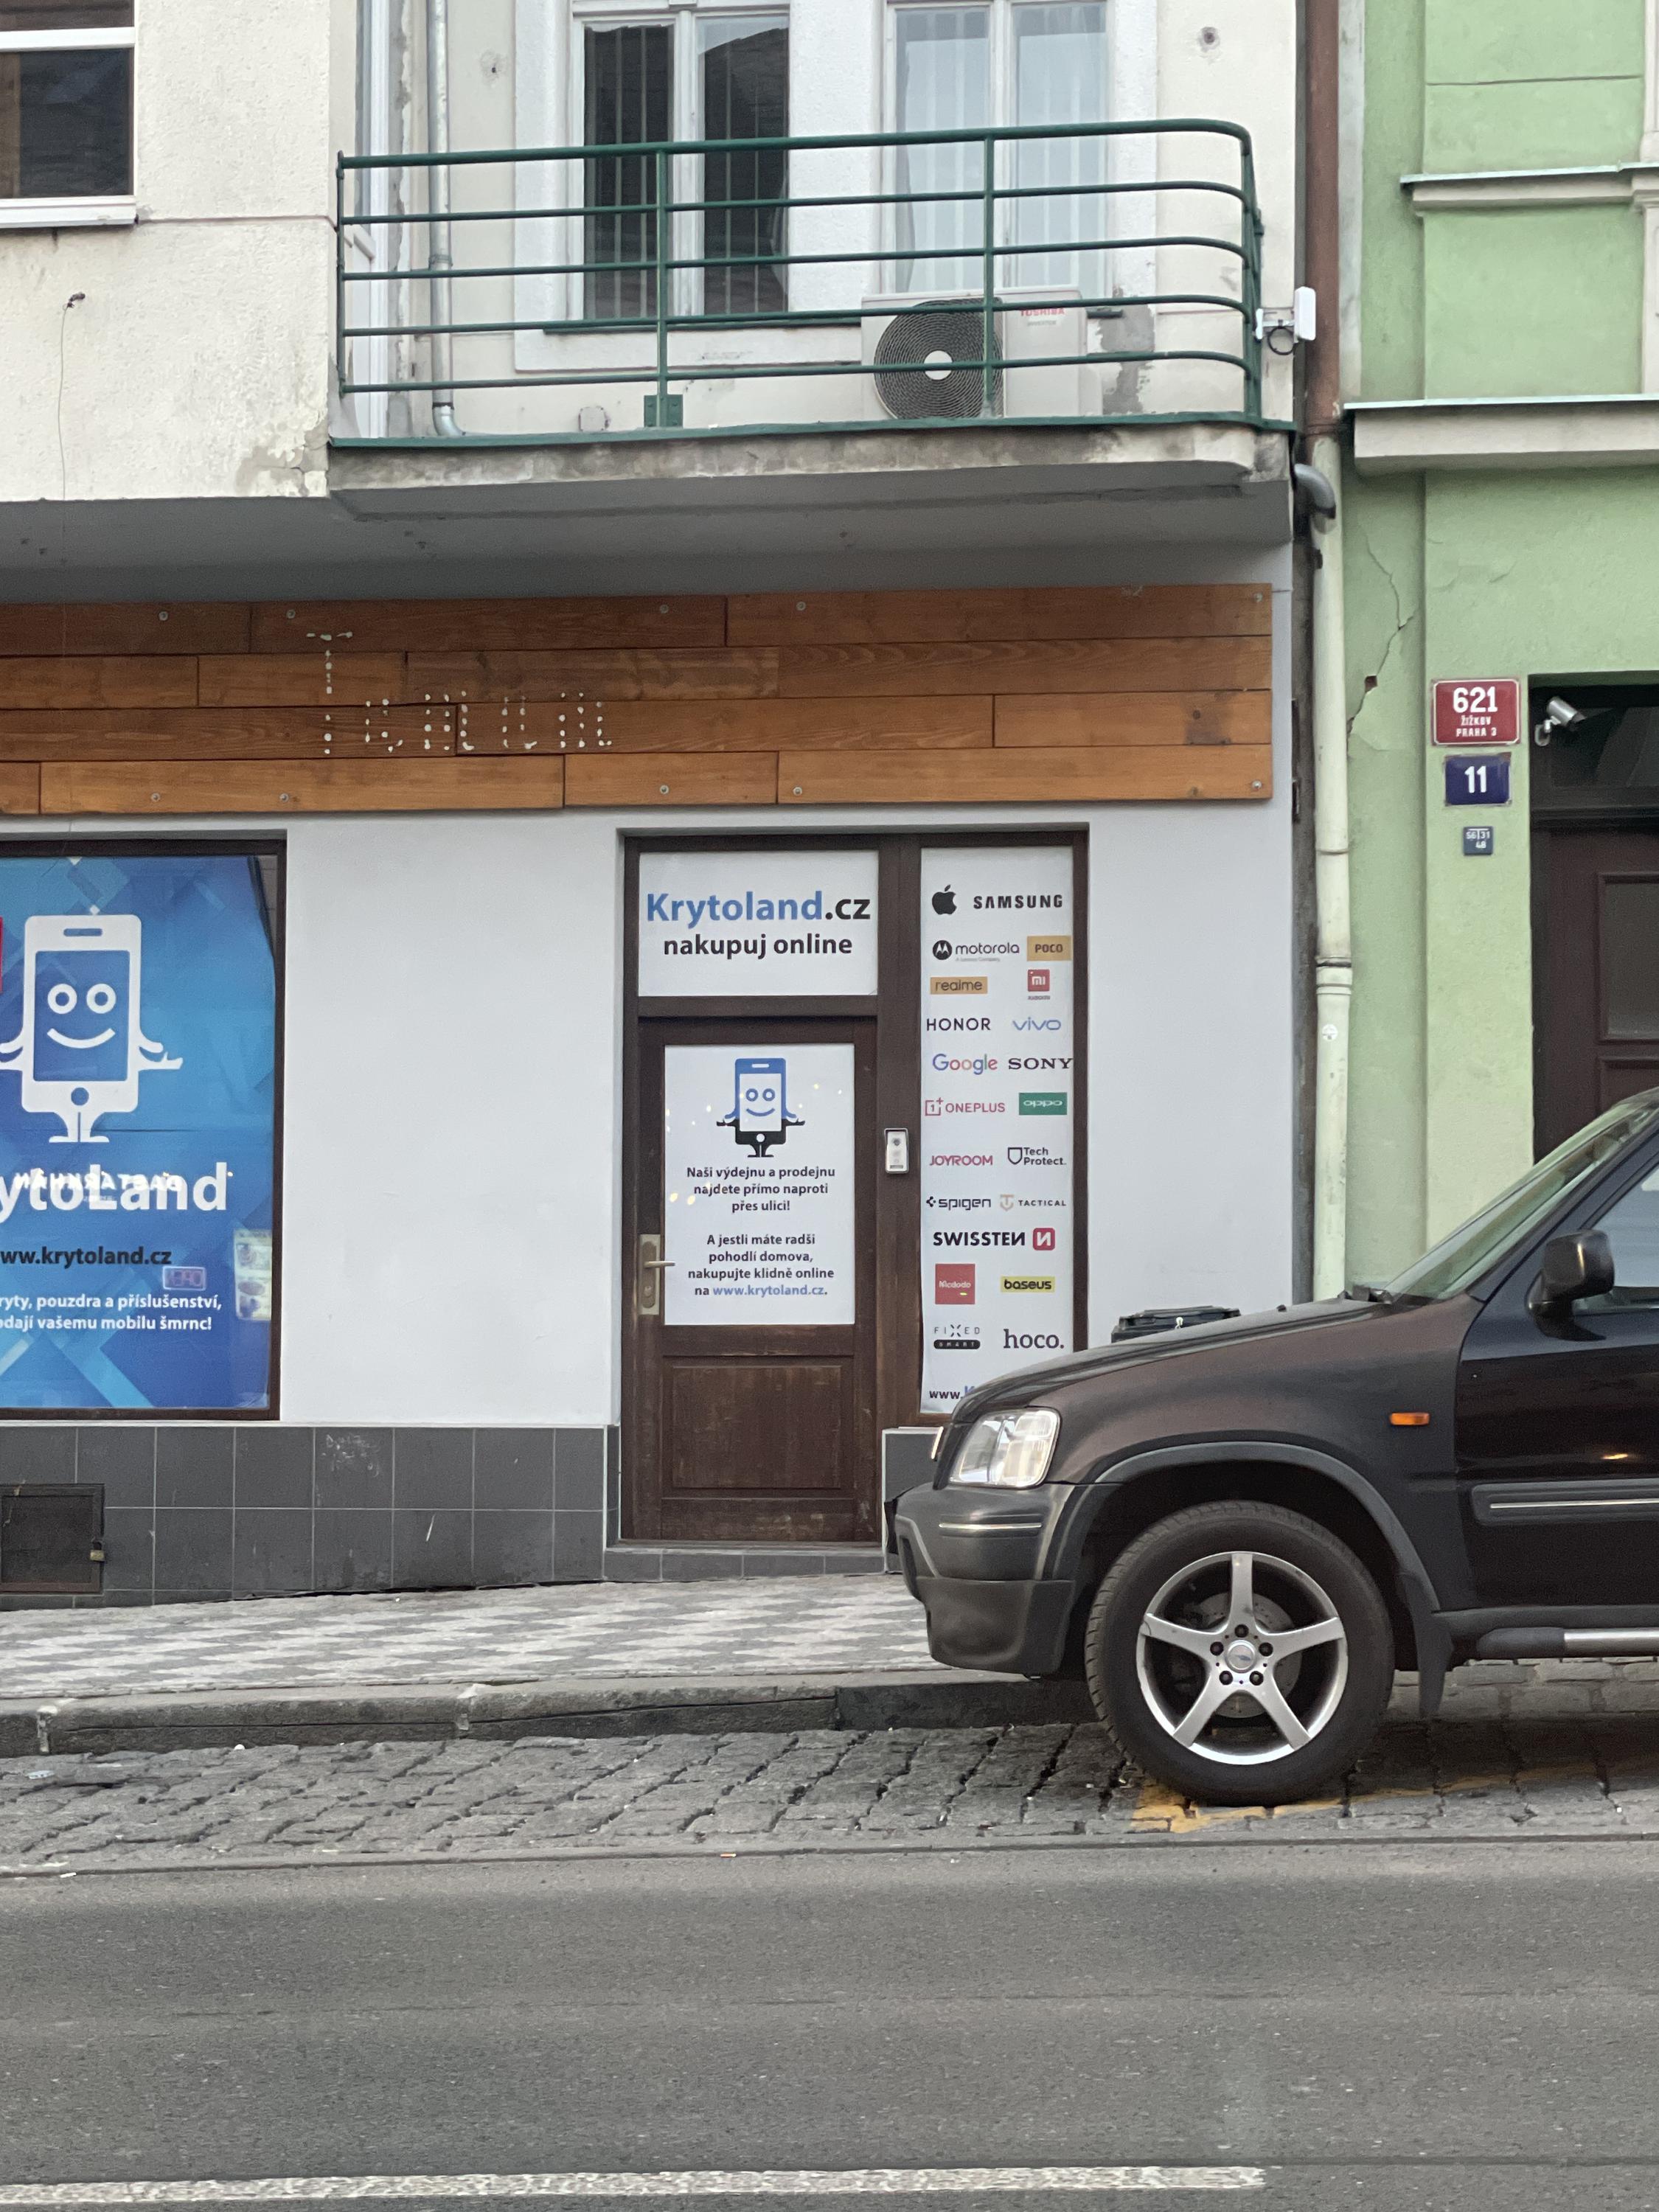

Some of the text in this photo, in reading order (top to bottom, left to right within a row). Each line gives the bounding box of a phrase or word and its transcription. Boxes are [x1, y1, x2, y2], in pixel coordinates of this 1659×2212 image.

[1453, 686, 1498, 713] 621
[1461, 714, 1492, 726] ŽIŽKOV
[1455, 726, 1497, 737] PRAHA 3
[1464, 765, 1487, 793] 11
[973, 894, 1063, 909] SAMSUNG
[647, 890, 872, 929] Krytoland.cz
[664, 933, 853, 960] nakupuj online
[955, 942, 1020, 955] motorola
[1034, 944, 1064, 953] POCO
[935, 980, 983, 991] realme
[926, 1018, 991, 1031] HONOR
[1012, 1017, 1062, 1031] vivo
[932, 1053, 998, 1075] Google
[1008, 1057, 1074, 1070] SONY
[945, 1102, 1006, 1113] ONEPLUS
[1023, 1100, 1063, 1108] oppo
[1023, 1147, 1048, 1156] Tech
[929, 1155, 993, 1166] JOYROOM
[686, 1166, 835, 1180] Naši výdejnu a prodejnu
[694, 1183, 828, 1197] najdete přímo naproti
[731, 1200, 790, 1214] přes ulici!
[938, 1198, 992, 1211] spigen
[706, 1234, 815, 1248] A jestli máte radši
[709, 1251, 813, 1264] pohodlí domova,
[688, 1267, 835, 1281] nakupujte klidně online
[695, 1284, 828, 1298] na www.krytoland.cz.
[1004, 1279, 1052, 1290] baseus
[37, 1293, 102, 1311] pouzdra
[105, 1296, 114, 1308] a
[117, 1293, 222, 1311] příslušenství,
[38, 1315, 97, 1329] vašemu
[101, 1315, 156, 1329] mobilu
[160, 1316, 212, 1330] šmrnc!
[933, 1324, 981, 1338] FIXED
[1003, 1328, 1065, 1349] hoco.
